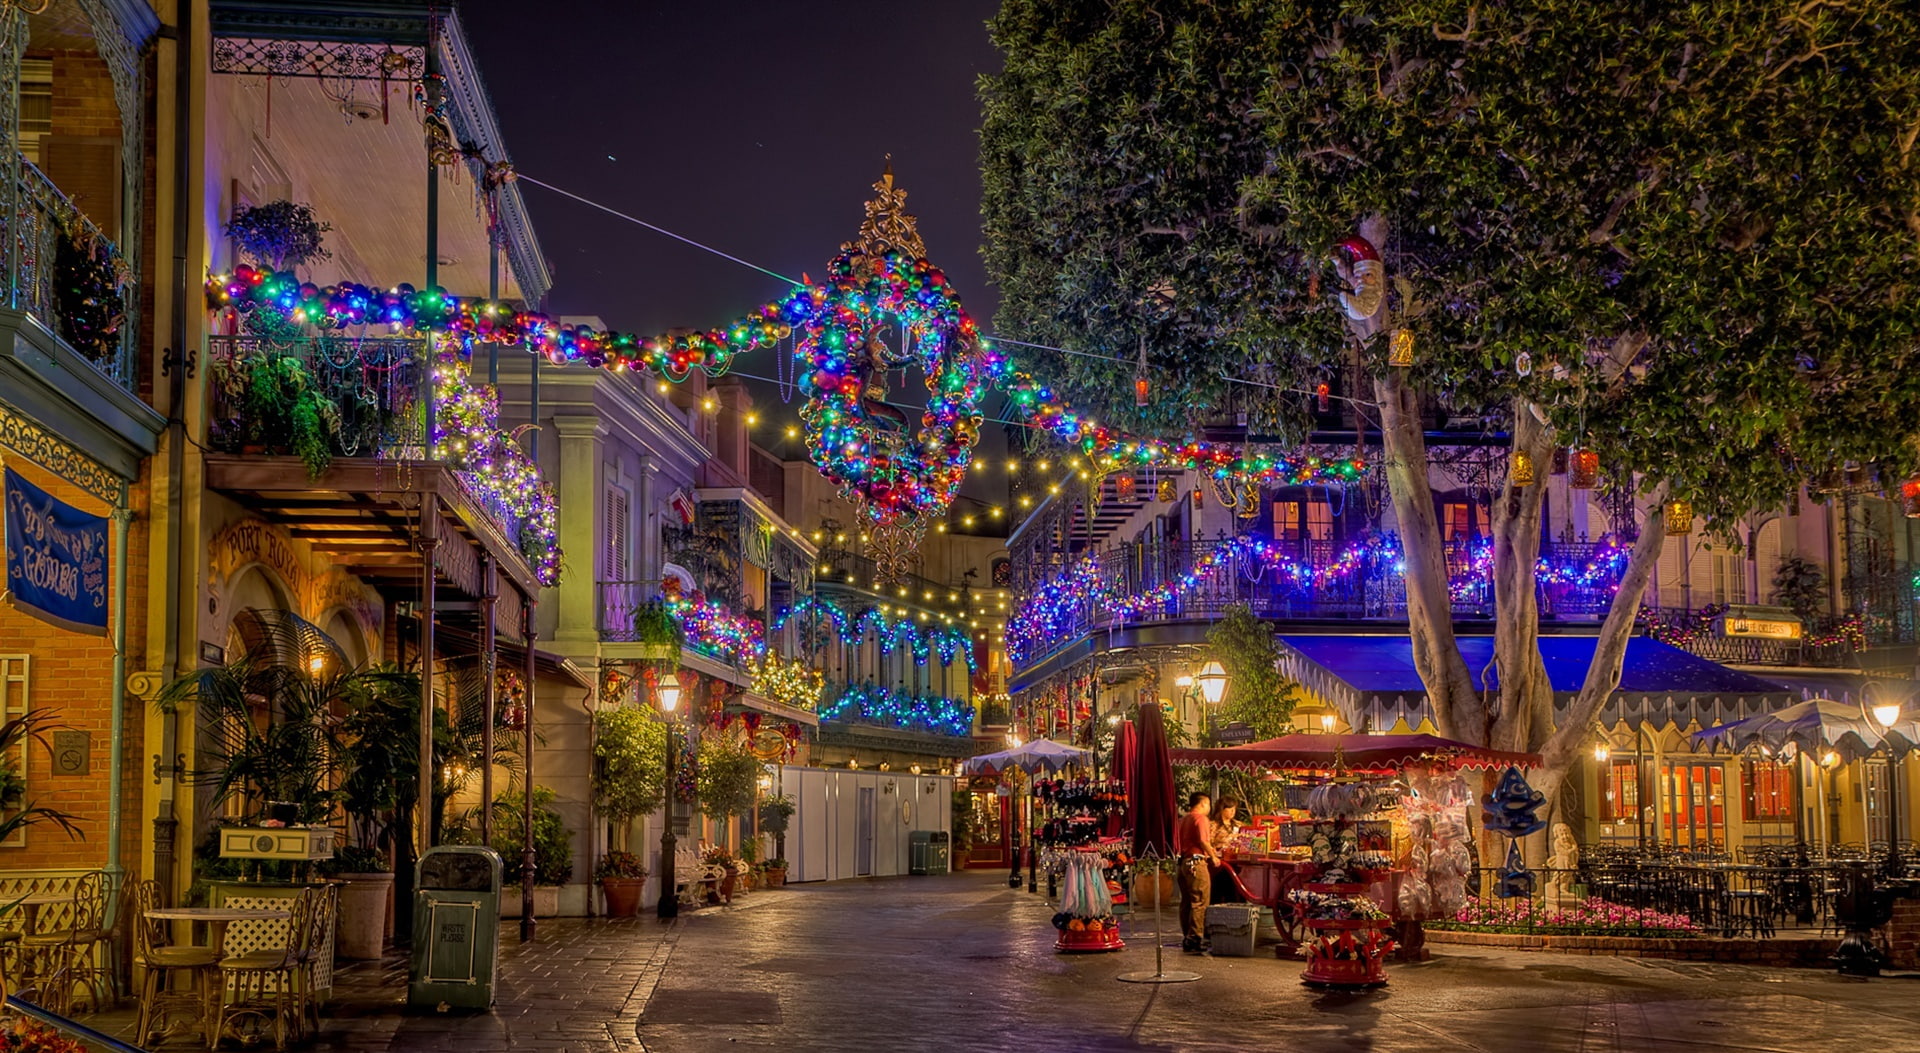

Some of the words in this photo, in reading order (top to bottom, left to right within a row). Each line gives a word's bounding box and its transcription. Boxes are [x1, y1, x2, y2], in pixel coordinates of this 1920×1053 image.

[23, 545, 79, 601] GUMBO
[227, 525, 262, 566] PORT
[265, 531, 301, 597] ROYAL
[1221, 730, 1252, 738] ESPLANADE
[440, 933, 464, 943] PLEASE
